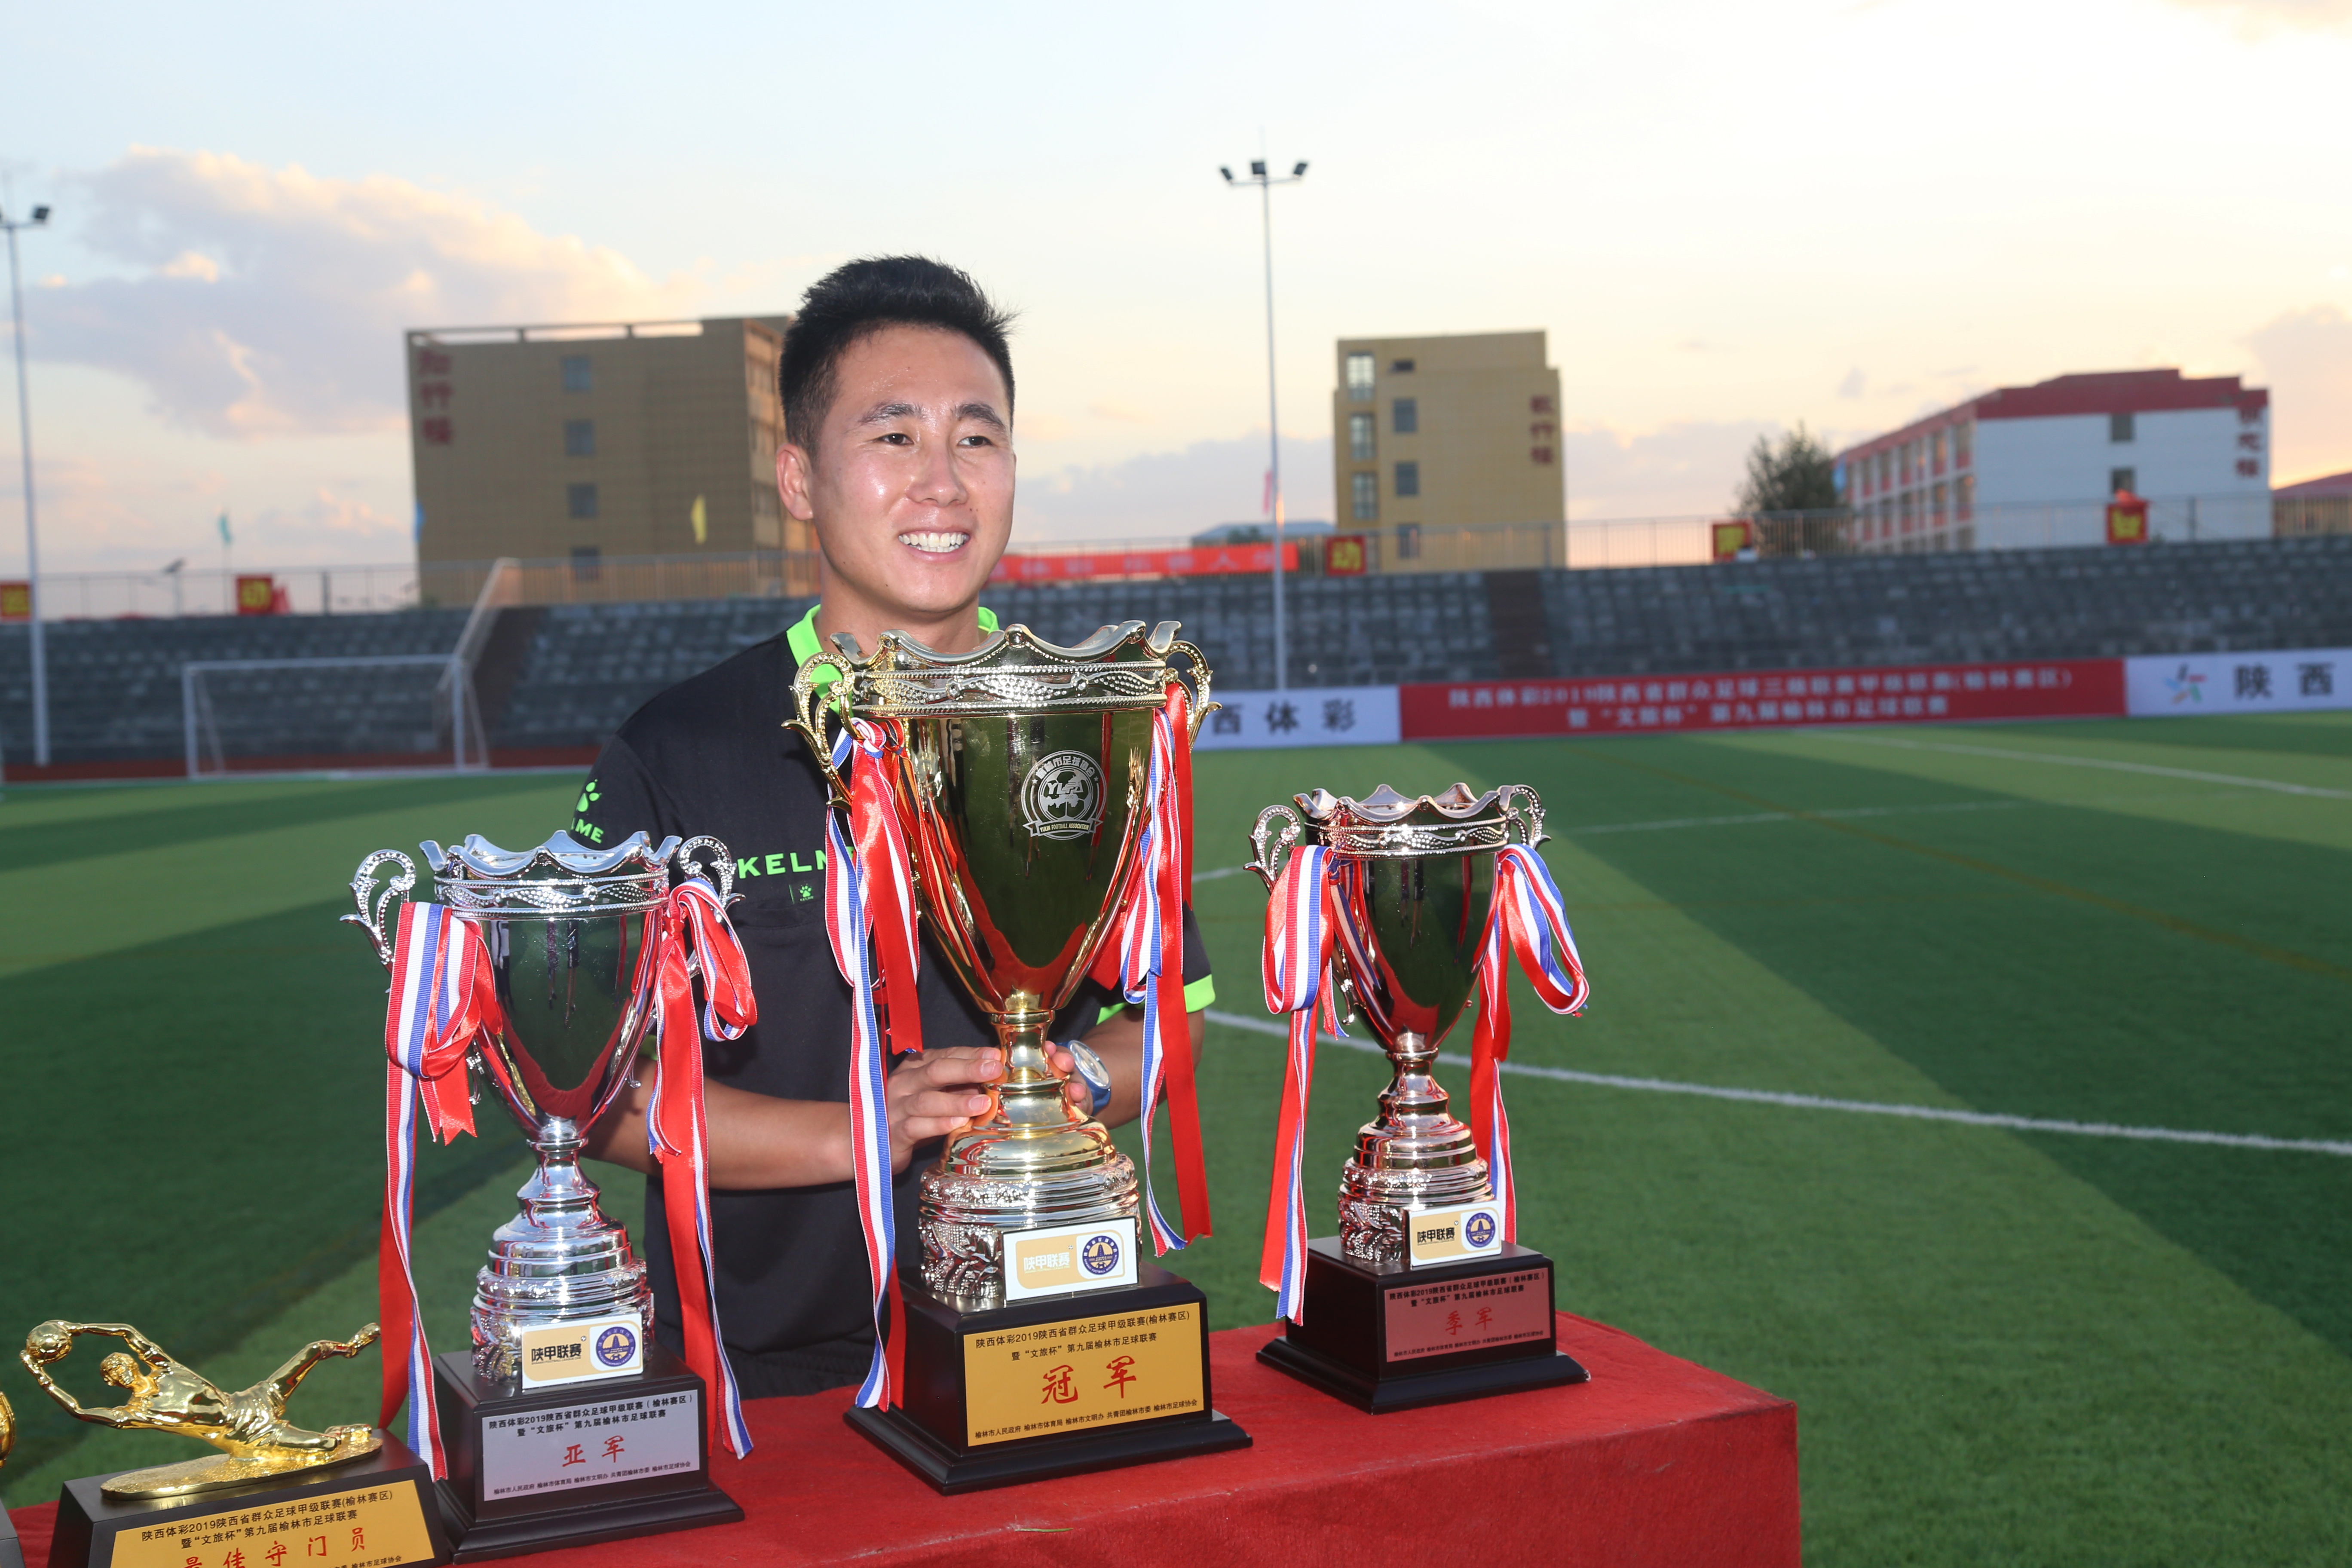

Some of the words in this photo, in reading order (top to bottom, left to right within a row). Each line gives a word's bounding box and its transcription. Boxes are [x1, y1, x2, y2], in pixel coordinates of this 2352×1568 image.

[1417, 1227, 1455, 1243] 陕甲联赛
[1023, 1252, 1070, 1271] 陕甲联赛
[1446, 1307, 1493, 1335] 季军
[531, 1343, 581, 1362] 陕甲联赛
[1041, 1356, 1136, 1404] 冠军
[975, 1426, 1021, 1439] 榆林市人民政府
[1024, 1419, 1063, 1431] 榆林市体育局
[1066, 1413, 1104, 1425] 榆林市文明办
[1107, 1406, 1151, 1419] 共青团榆林市委
[1154, 1399, 1197, 1412] 榆林市足球协会
[562, 1435, 625, 1467] 亚军
[493, 1484, 535, 1494] 榆林市人民政府
[537, 1478, 572, 1488] 榆林市体育局
[652, 1461, 691, 1472] 榆林市足球协会
[351, 1555, 401, 1568] 榆林市足球协会
